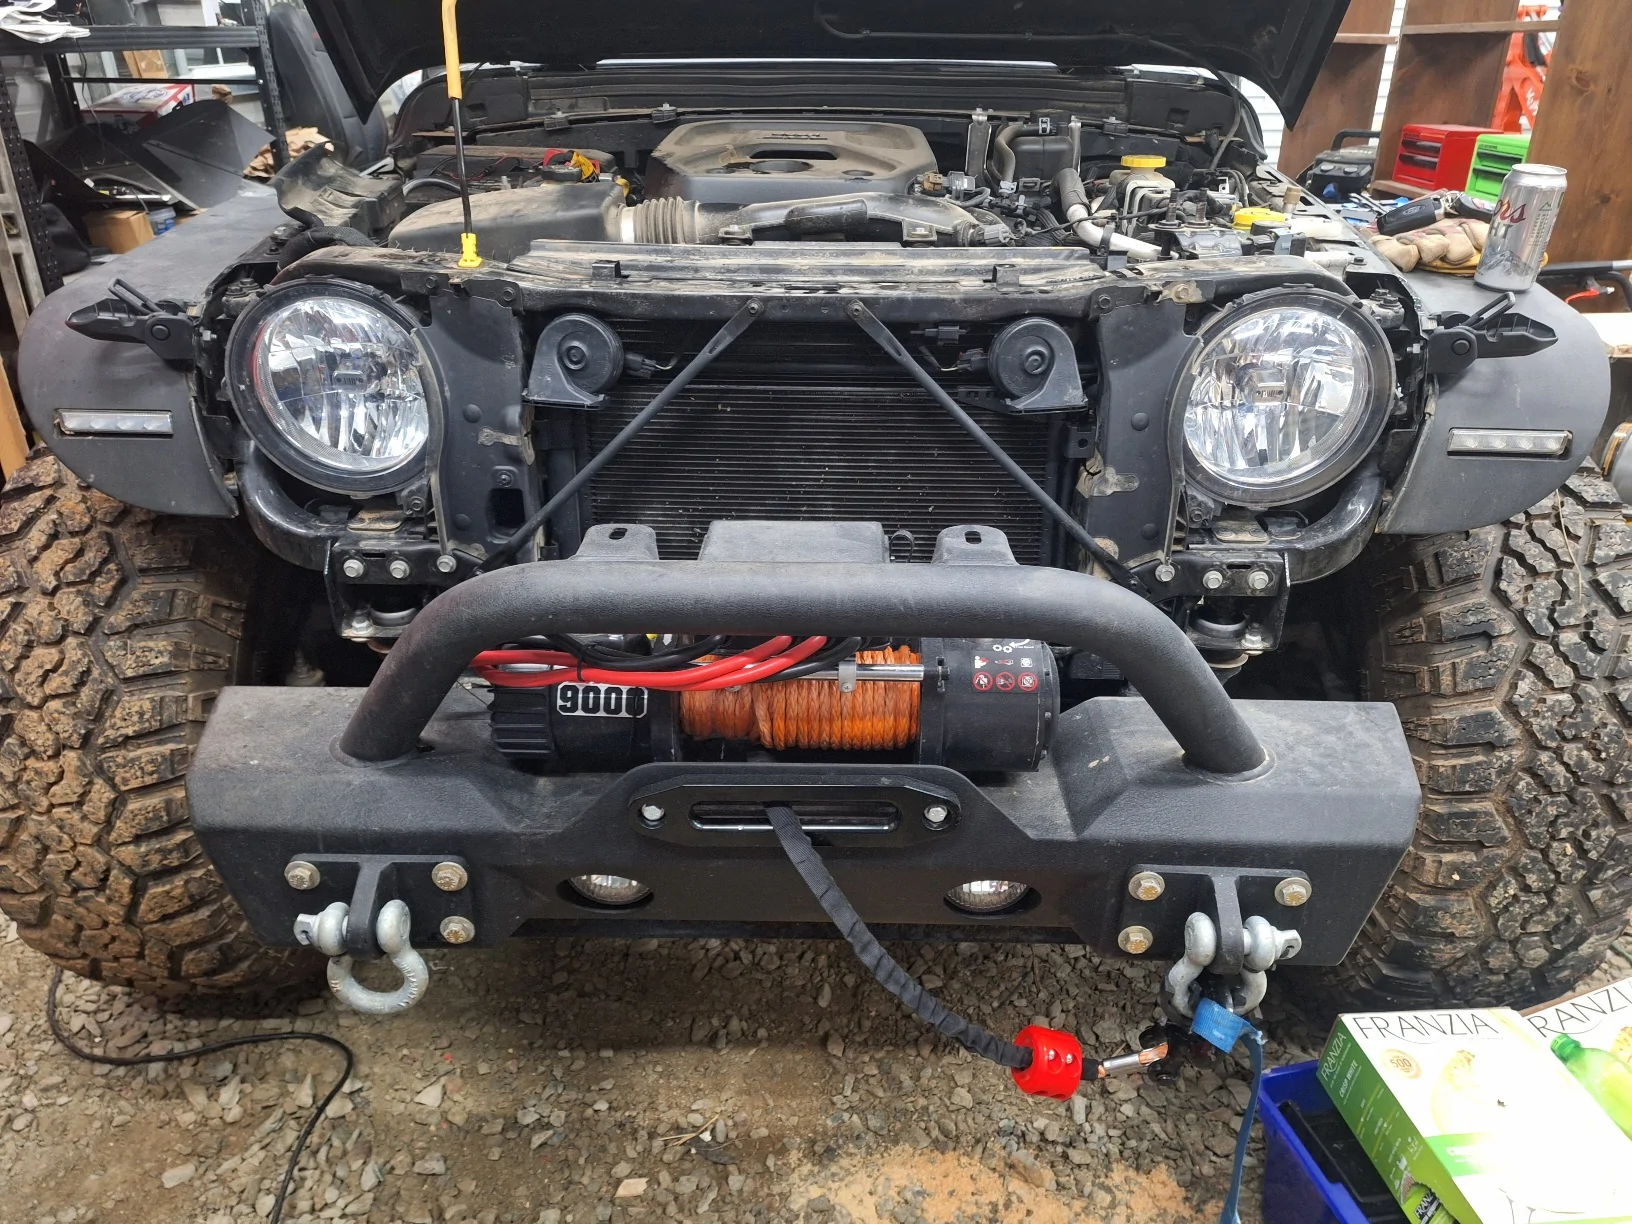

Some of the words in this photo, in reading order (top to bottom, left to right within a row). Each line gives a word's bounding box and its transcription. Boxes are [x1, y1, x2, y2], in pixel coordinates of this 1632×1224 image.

[1493, 199, 1526, 223] ors
[559, 684, 645, 715] 9000
[1527, 981, 1632, 1038] RANZI
[1352, 1013, 1499, 1044] FRANZIA
[1320, 1032, 1346, 1081] FRANZIA
[1346, 1059, 1359, 1080] WHITE
[1413, 1190, 1435, 1218] FRANZ
